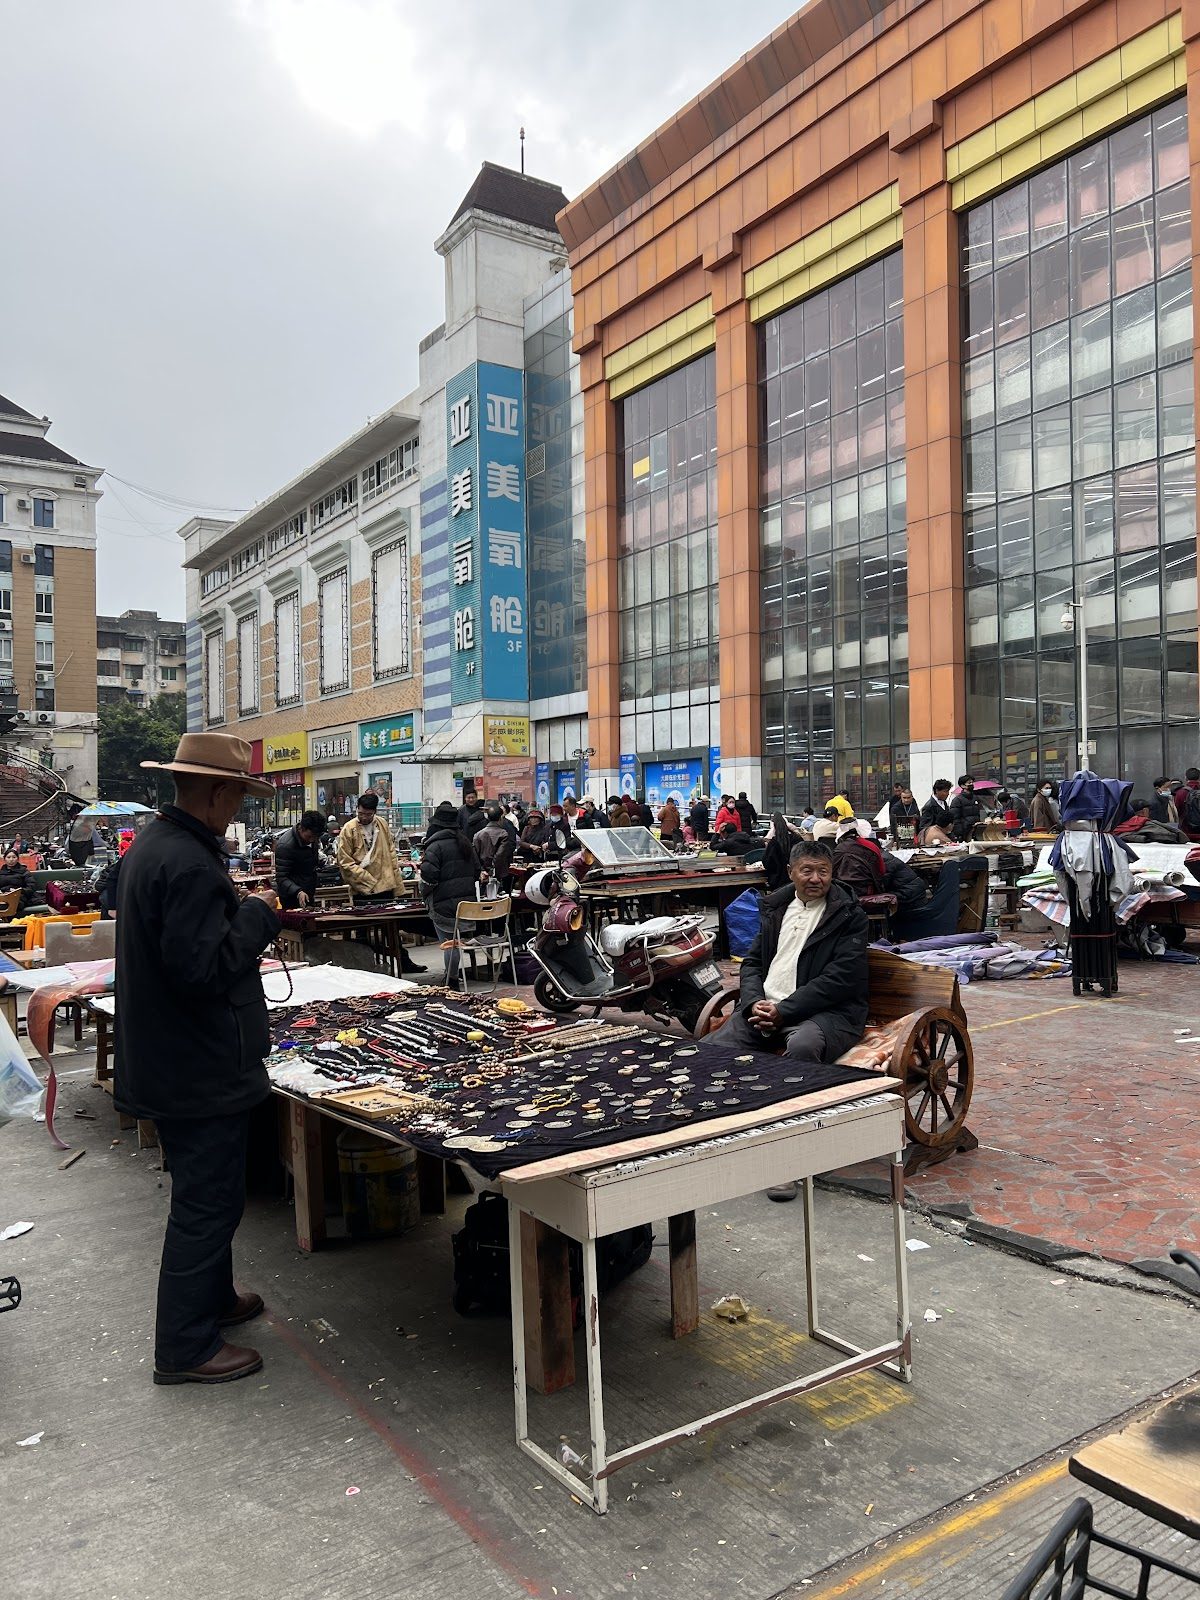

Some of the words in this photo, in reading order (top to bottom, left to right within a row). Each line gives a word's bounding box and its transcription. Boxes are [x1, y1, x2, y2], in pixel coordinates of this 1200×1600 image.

[451, 394, 474, 652] 亚美氧舱
[486, 393, 524, 634] 亚美氧舱
[465, 661, 475, 676] 3F
[507, 639, 523, 653] 3F
